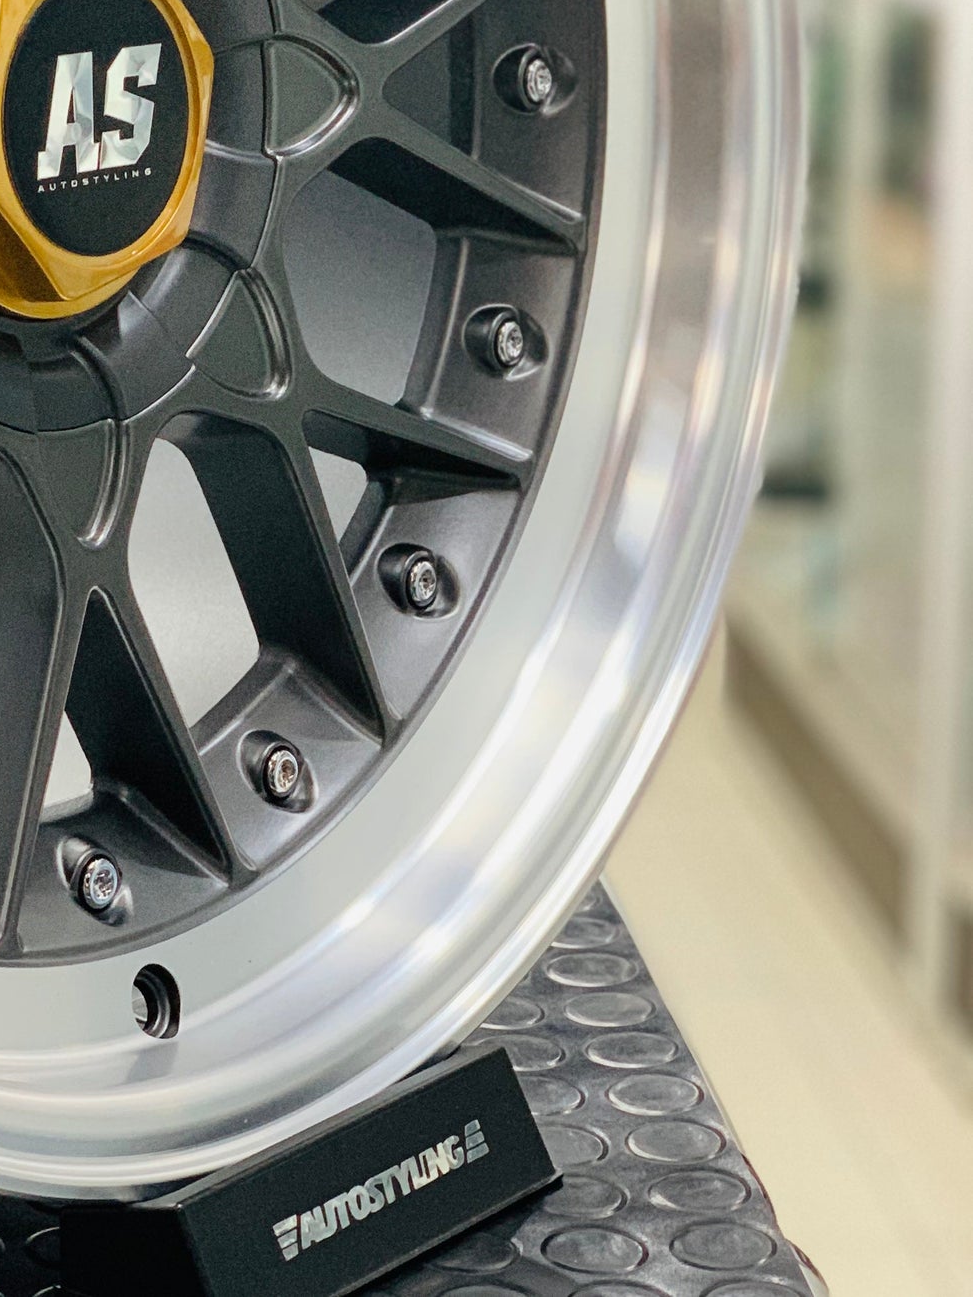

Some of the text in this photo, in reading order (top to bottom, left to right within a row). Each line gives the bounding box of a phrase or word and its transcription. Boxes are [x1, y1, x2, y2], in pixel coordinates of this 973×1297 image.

[37, 43, 162, 180] AS
[37, 167, 152, 193] AUTOSTYLING
[300, 1134, 465, 1250] AUTOSTYLING
